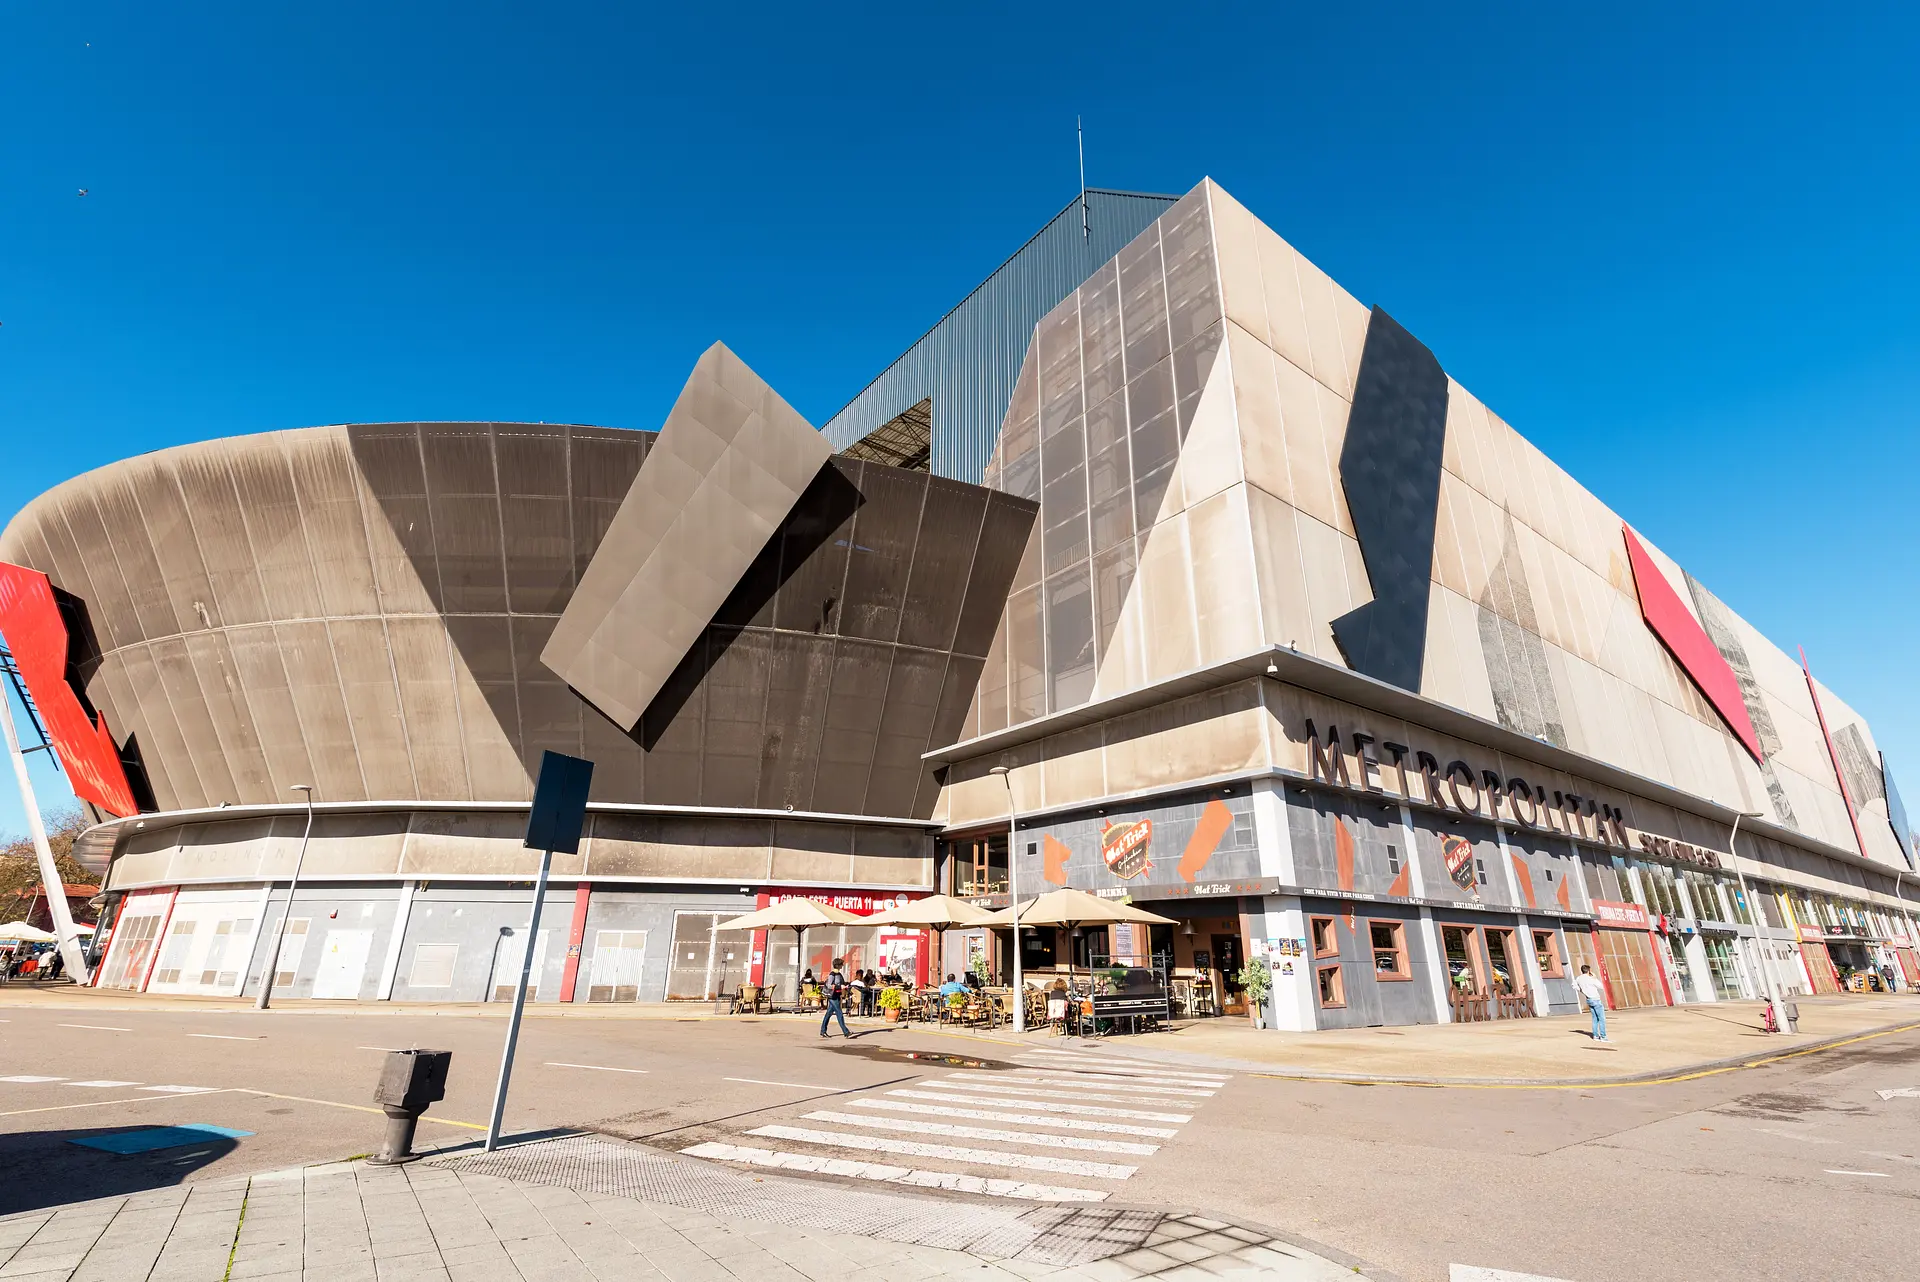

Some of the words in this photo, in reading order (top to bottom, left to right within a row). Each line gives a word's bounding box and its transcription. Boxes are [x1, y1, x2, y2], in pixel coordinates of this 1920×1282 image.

[1305, 717, 1631, 850] METROPOLITAN
[1105, 839, 1125, 864] Hat
[1123, 822, 1149, 849] Trick
[1447, 851, 1460, 872] Hat
[1457, 842, 1471, 862] Trick
[833, 895, 863, 909] PUERTA
[864, 896, 872, 910] 11
[1096, 887, 1128, 898] DRINKS
[1194, 884, 1210, 895] Hat
[1211, 883, 1231, 894] Trick
[1448, 984, 1491, 1023] Hat
[1491, 983, 1538, 1020] Trick
